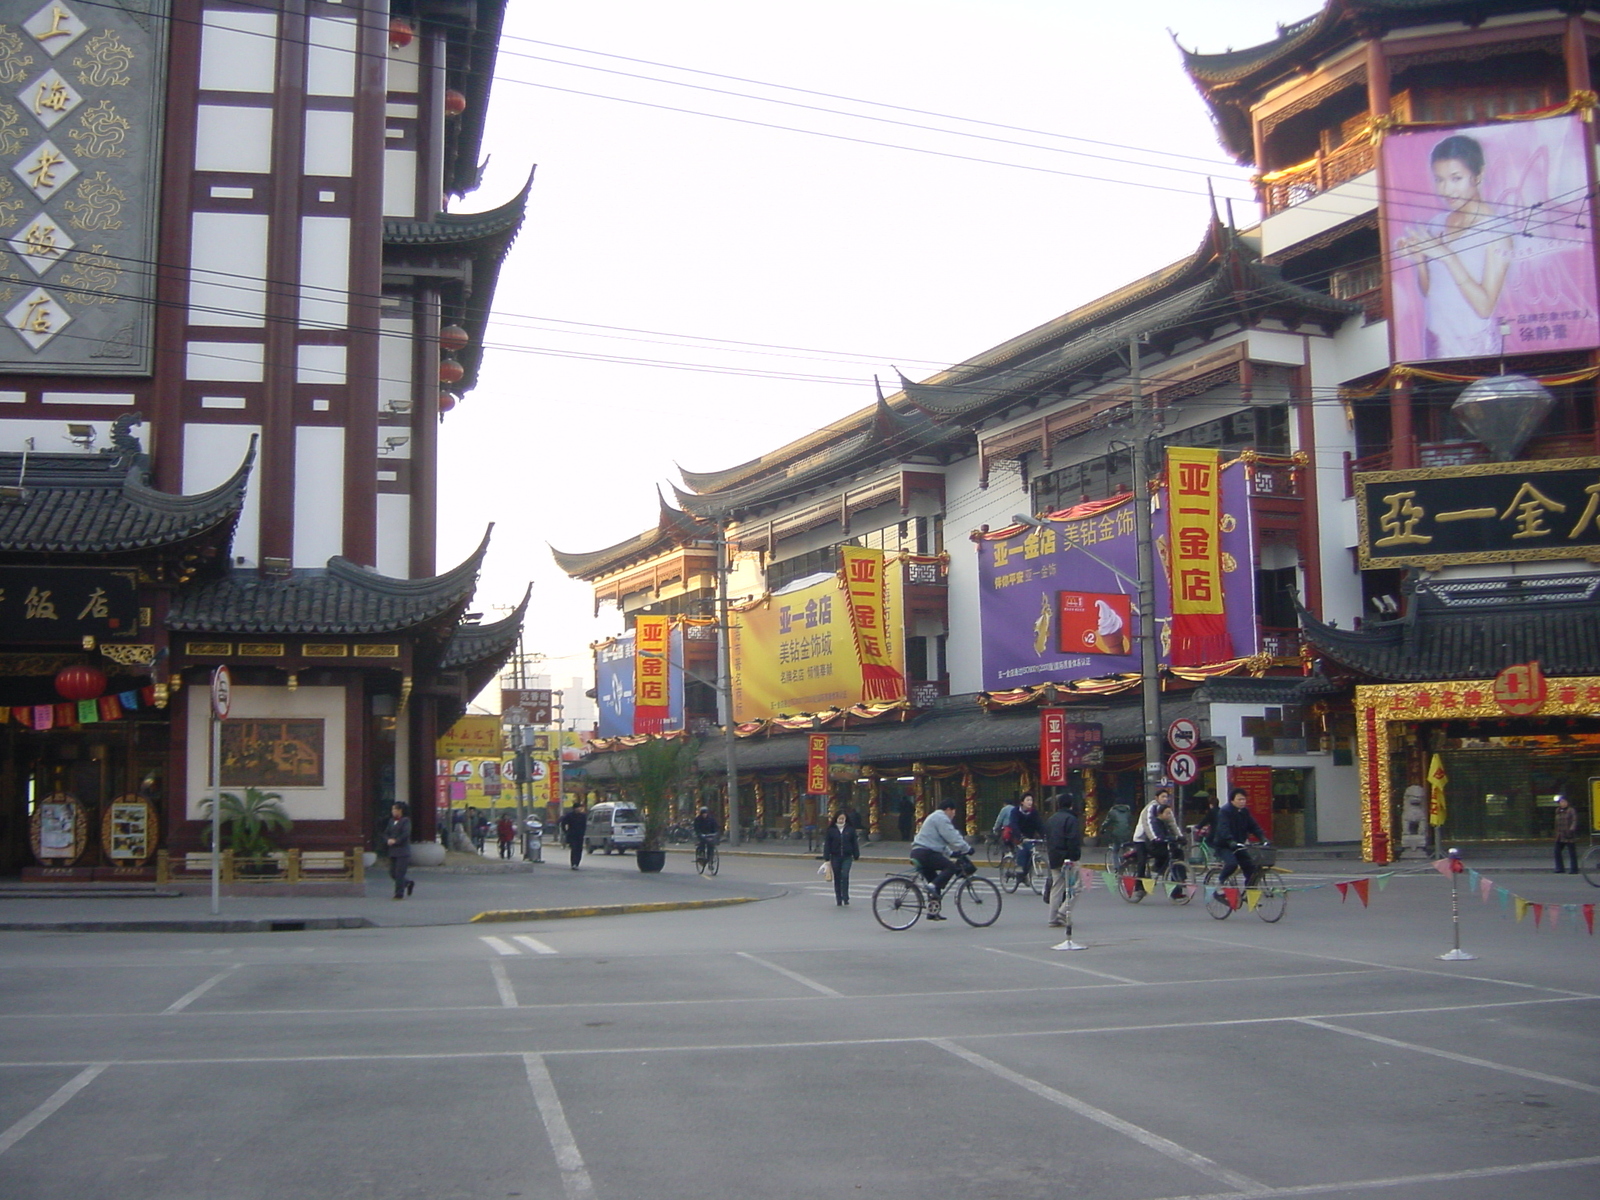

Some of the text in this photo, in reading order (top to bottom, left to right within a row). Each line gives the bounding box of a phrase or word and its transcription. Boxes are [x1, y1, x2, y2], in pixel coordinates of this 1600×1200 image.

[994, 528, 1056, 568] 亚一金店
[1178, 463, 1212, 602] 亚一金店
[779, 594, 833, 635] 亚一金店
[850, 558, 882, 659] 亚一金店
[641, 623, 663, 700] 亚一金店
[811, 738, 825, 790] 亚一金店
[1048, 719, 1061, 777] 亚一金店
